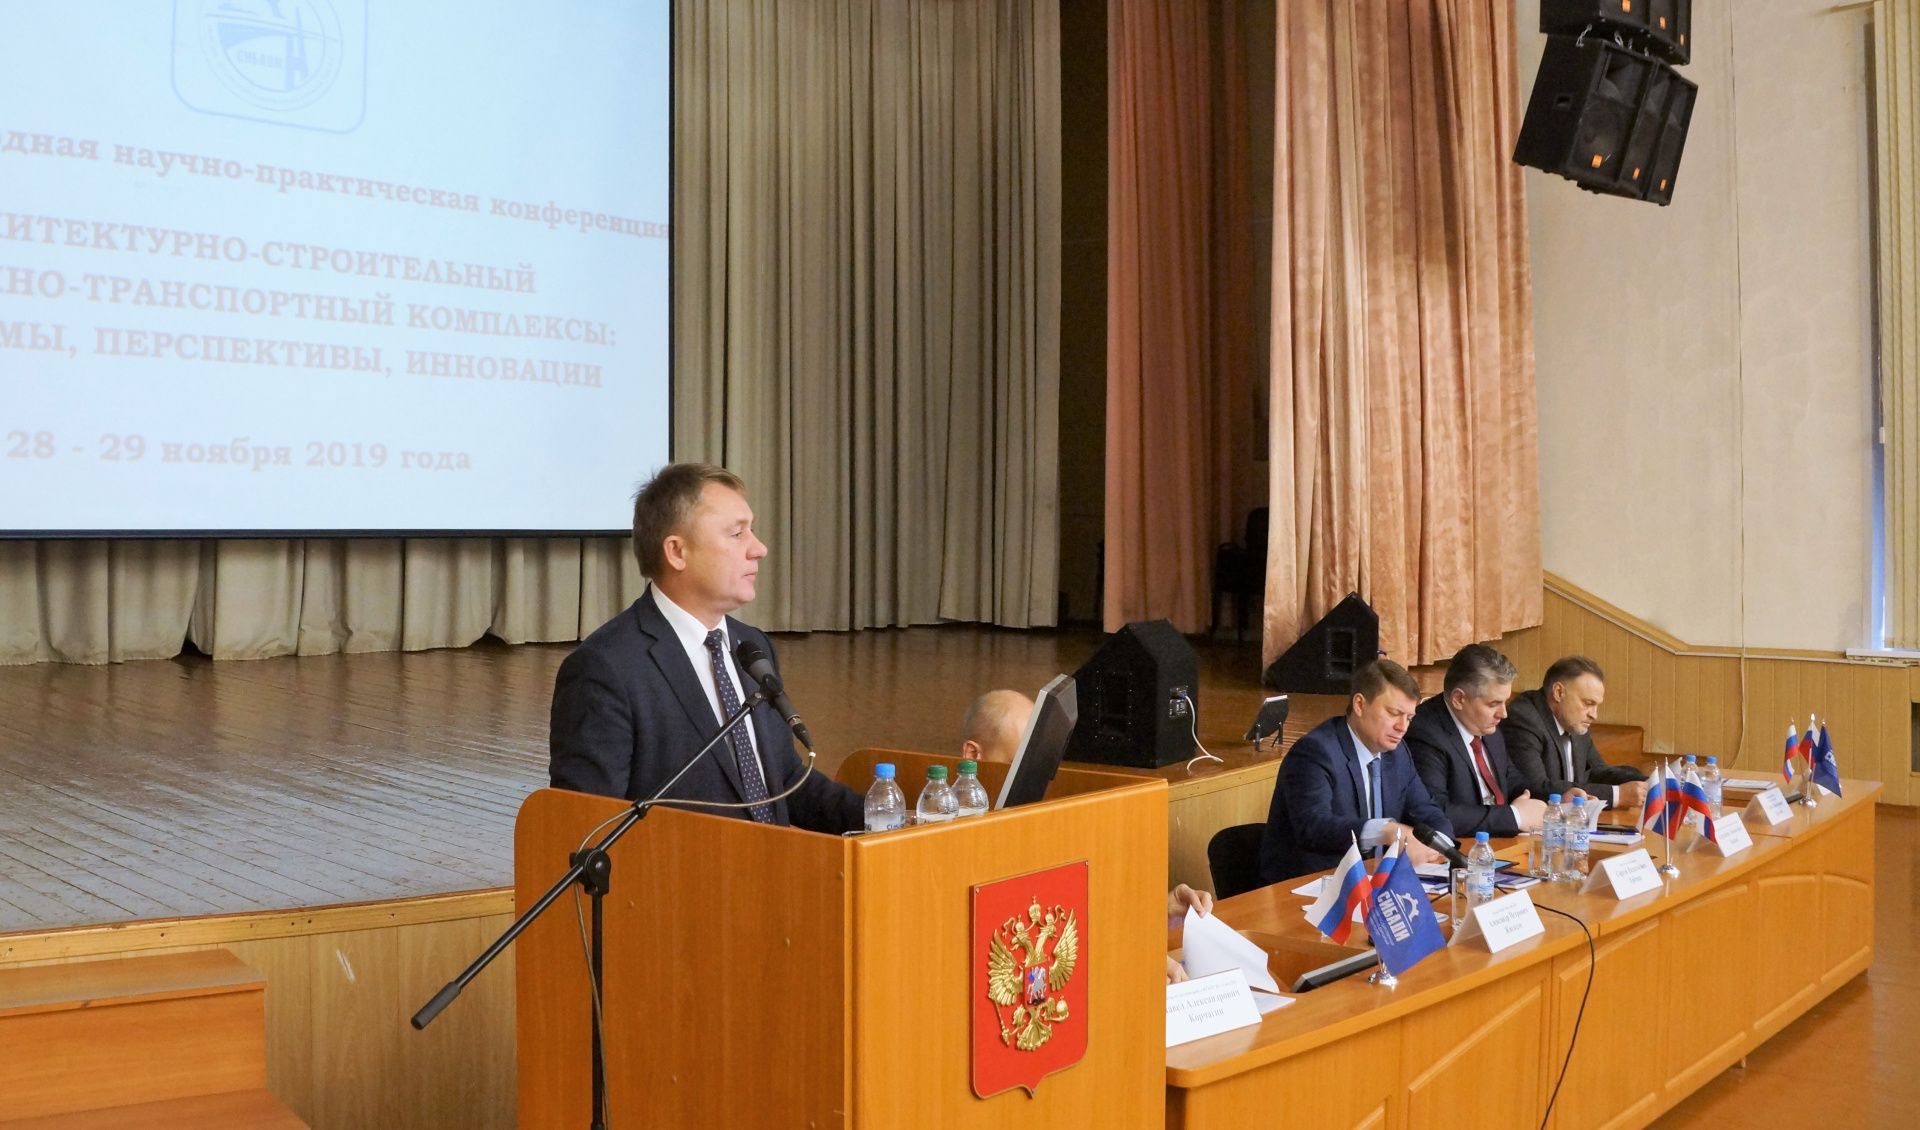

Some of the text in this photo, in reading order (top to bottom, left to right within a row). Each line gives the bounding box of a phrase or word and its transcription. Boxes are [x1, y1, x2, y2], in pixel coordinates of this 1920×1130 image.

[0, 131, 670, 239] дная научно-практическая конференция
[0, 212, 536, 294] ИТЕКТУРНО-СТРОИТЕЛЬНЫЙ
[0, 266, 617, 347] НО-ТРАНСПОРТНЫЙ КОМПЛЕКСЫ:
[94, 326, 393, 378] ПЕРСПЕКТИВЫ,
[405, 350, 603, 388] ИННОВАЦИИ
[5, 430, 56, 460] 28
[98, 433, 147, 463] 29
[161, 437, 293, 472] ноября
[304, 441, 390, 470] 2019
[400, 447, 473, 472] года
[1377, 891, 1411, 942] СИБАДИ
